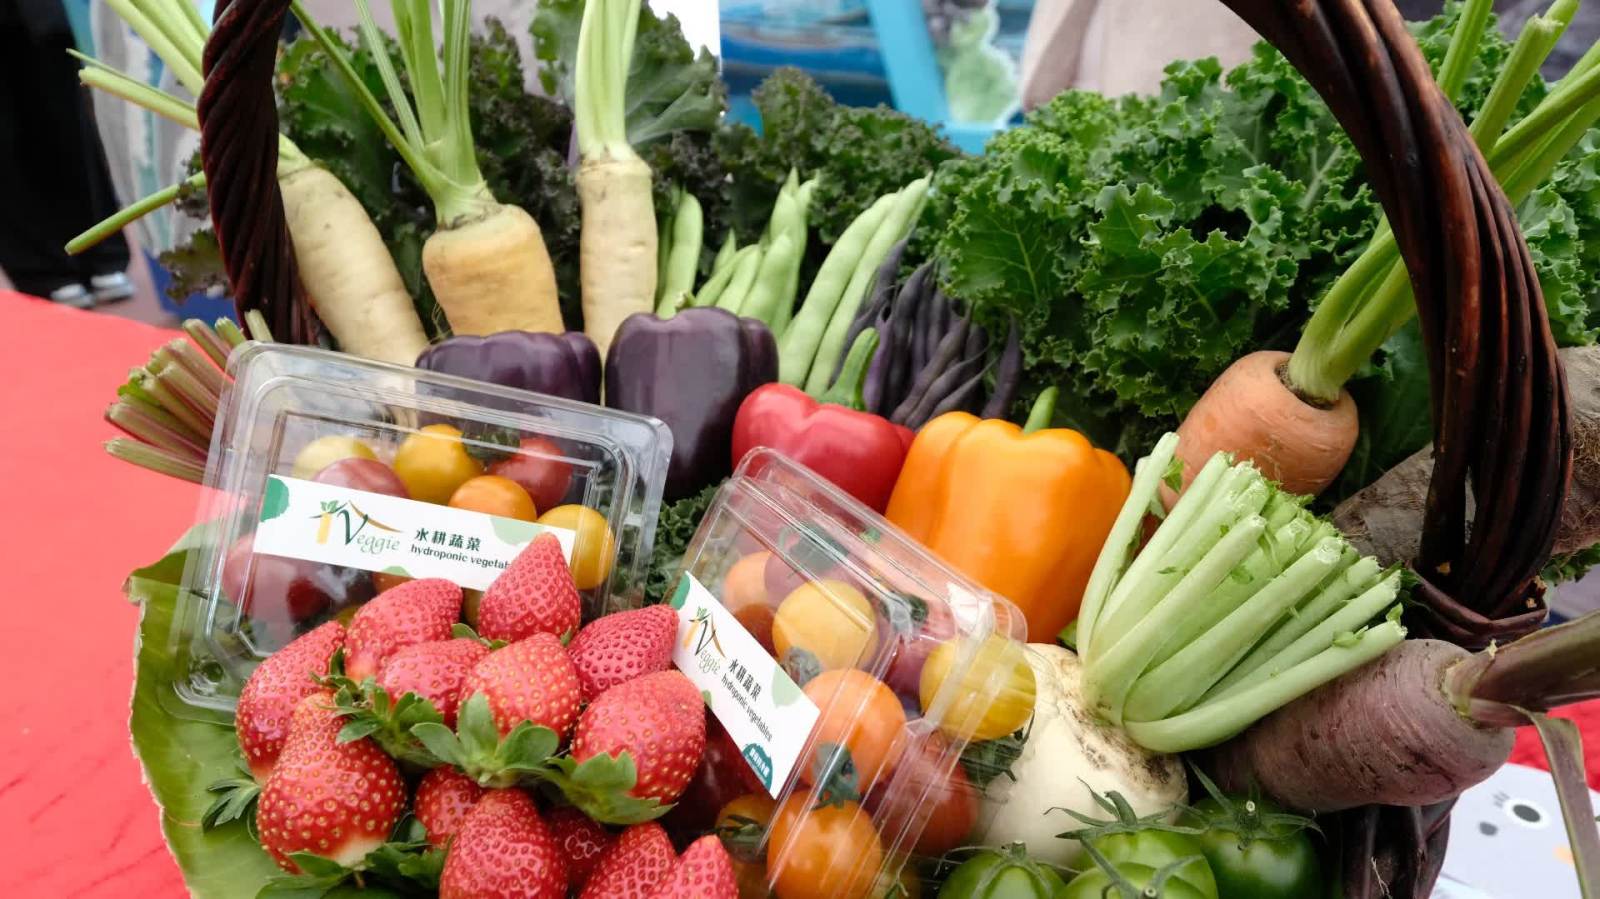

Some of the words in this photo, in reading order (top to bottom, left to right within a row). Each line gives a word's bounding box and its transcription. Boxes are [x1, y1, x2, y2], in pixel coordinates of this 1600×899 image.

[410, 544, 468, 563] hydroponic
[414, 527, 481, 552] 水耕蔬菜
[728, 659, 762, 701] 水耕蔬菜
[721, 673, 748, 708] hydroponic
[747, 706, 773, 742] vegetables
